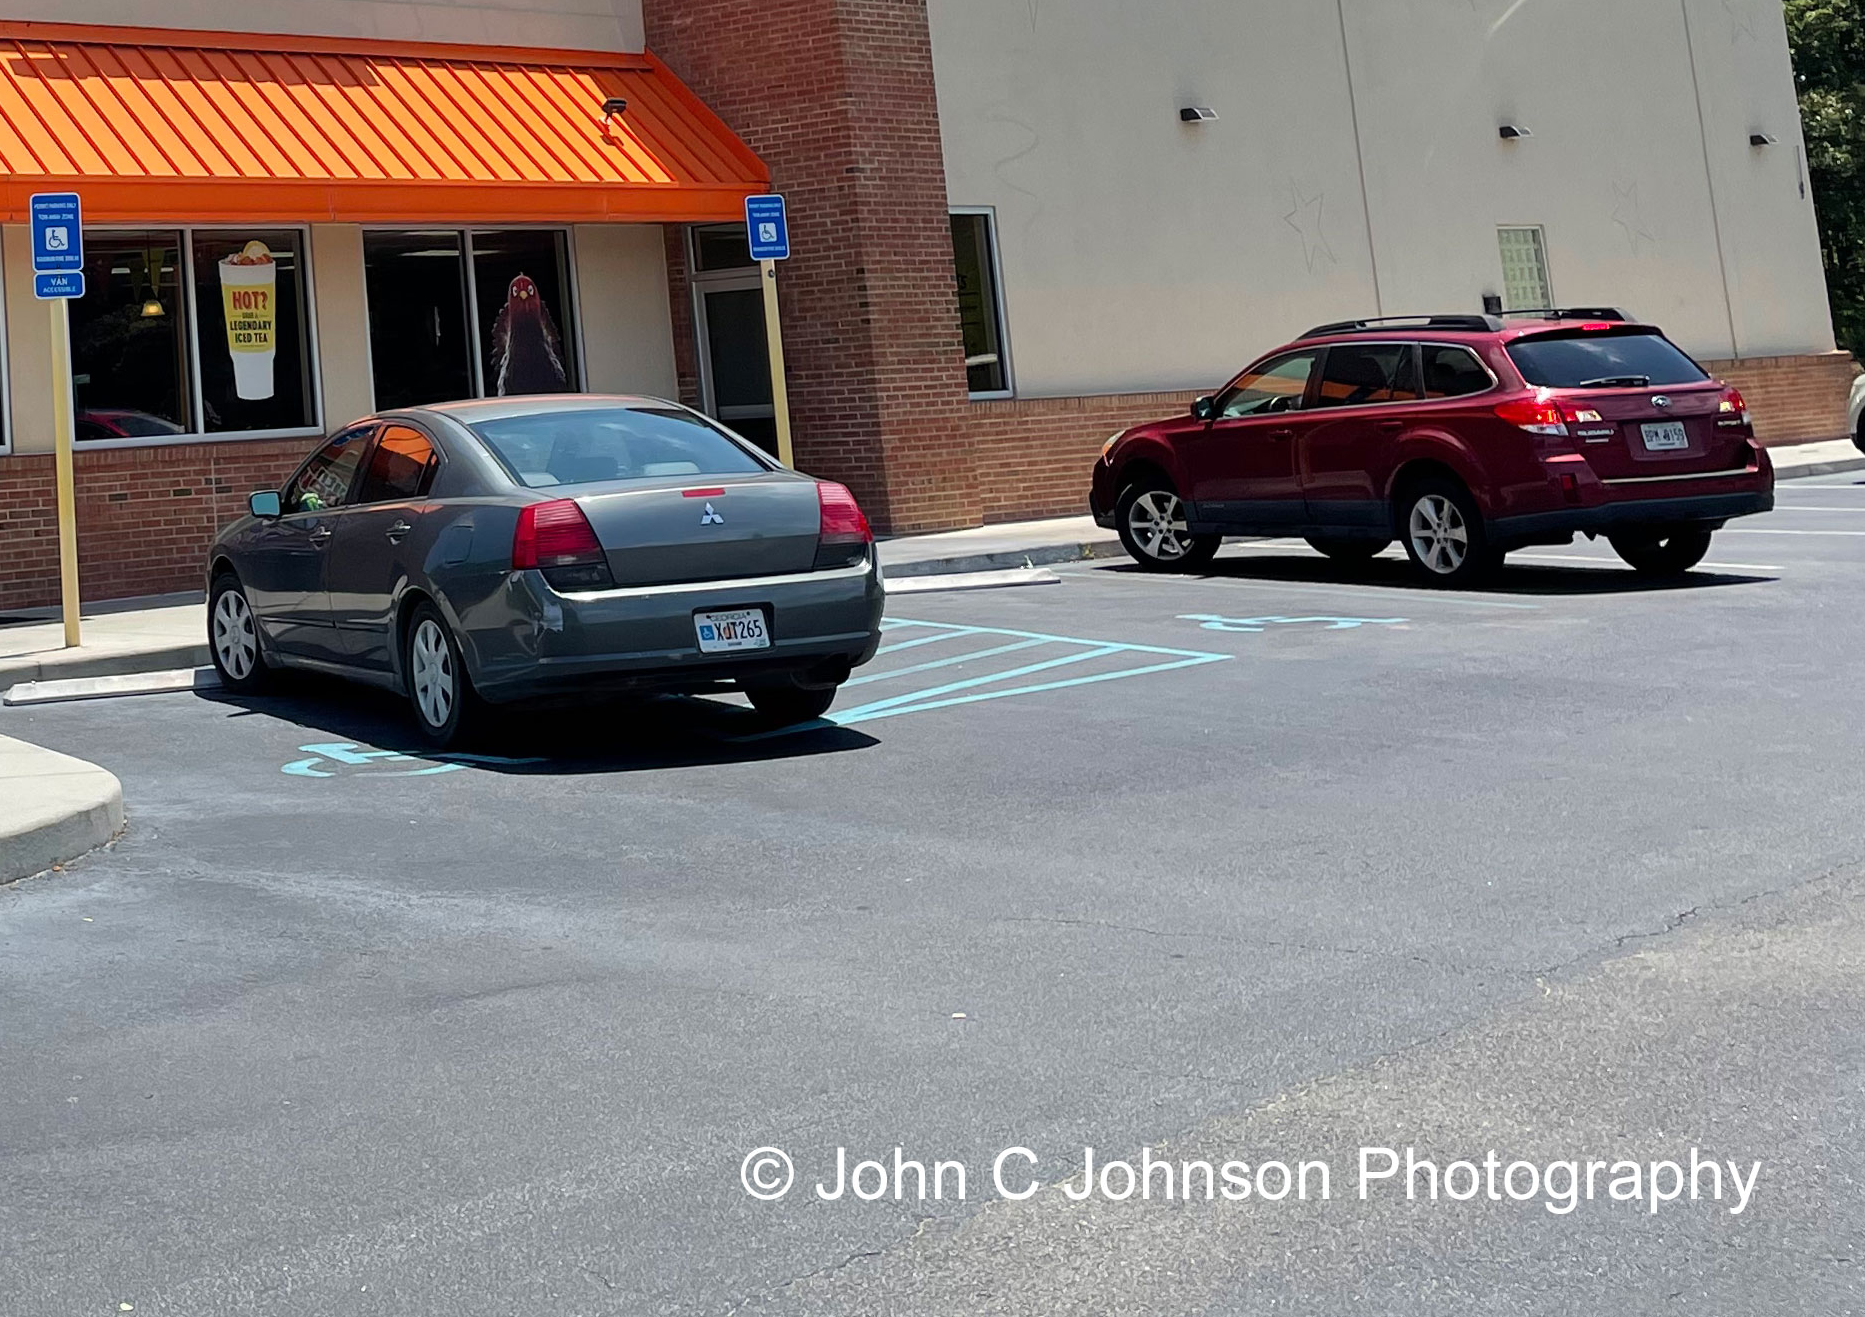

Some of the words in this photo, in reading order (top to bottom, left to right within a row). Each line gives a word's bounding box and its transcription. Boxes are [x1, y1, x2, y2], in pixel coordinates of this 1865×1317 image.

[50, 277, 68, 285] VAN
[42, 285, 76, 293] ACCESSIBLE
[232, 291, 268, 310] HOT?
[230, 320, 272, 331] LEGENDARY
[235, 332, 252, 343] ICED
[254, 332, 268, 343] TEA
